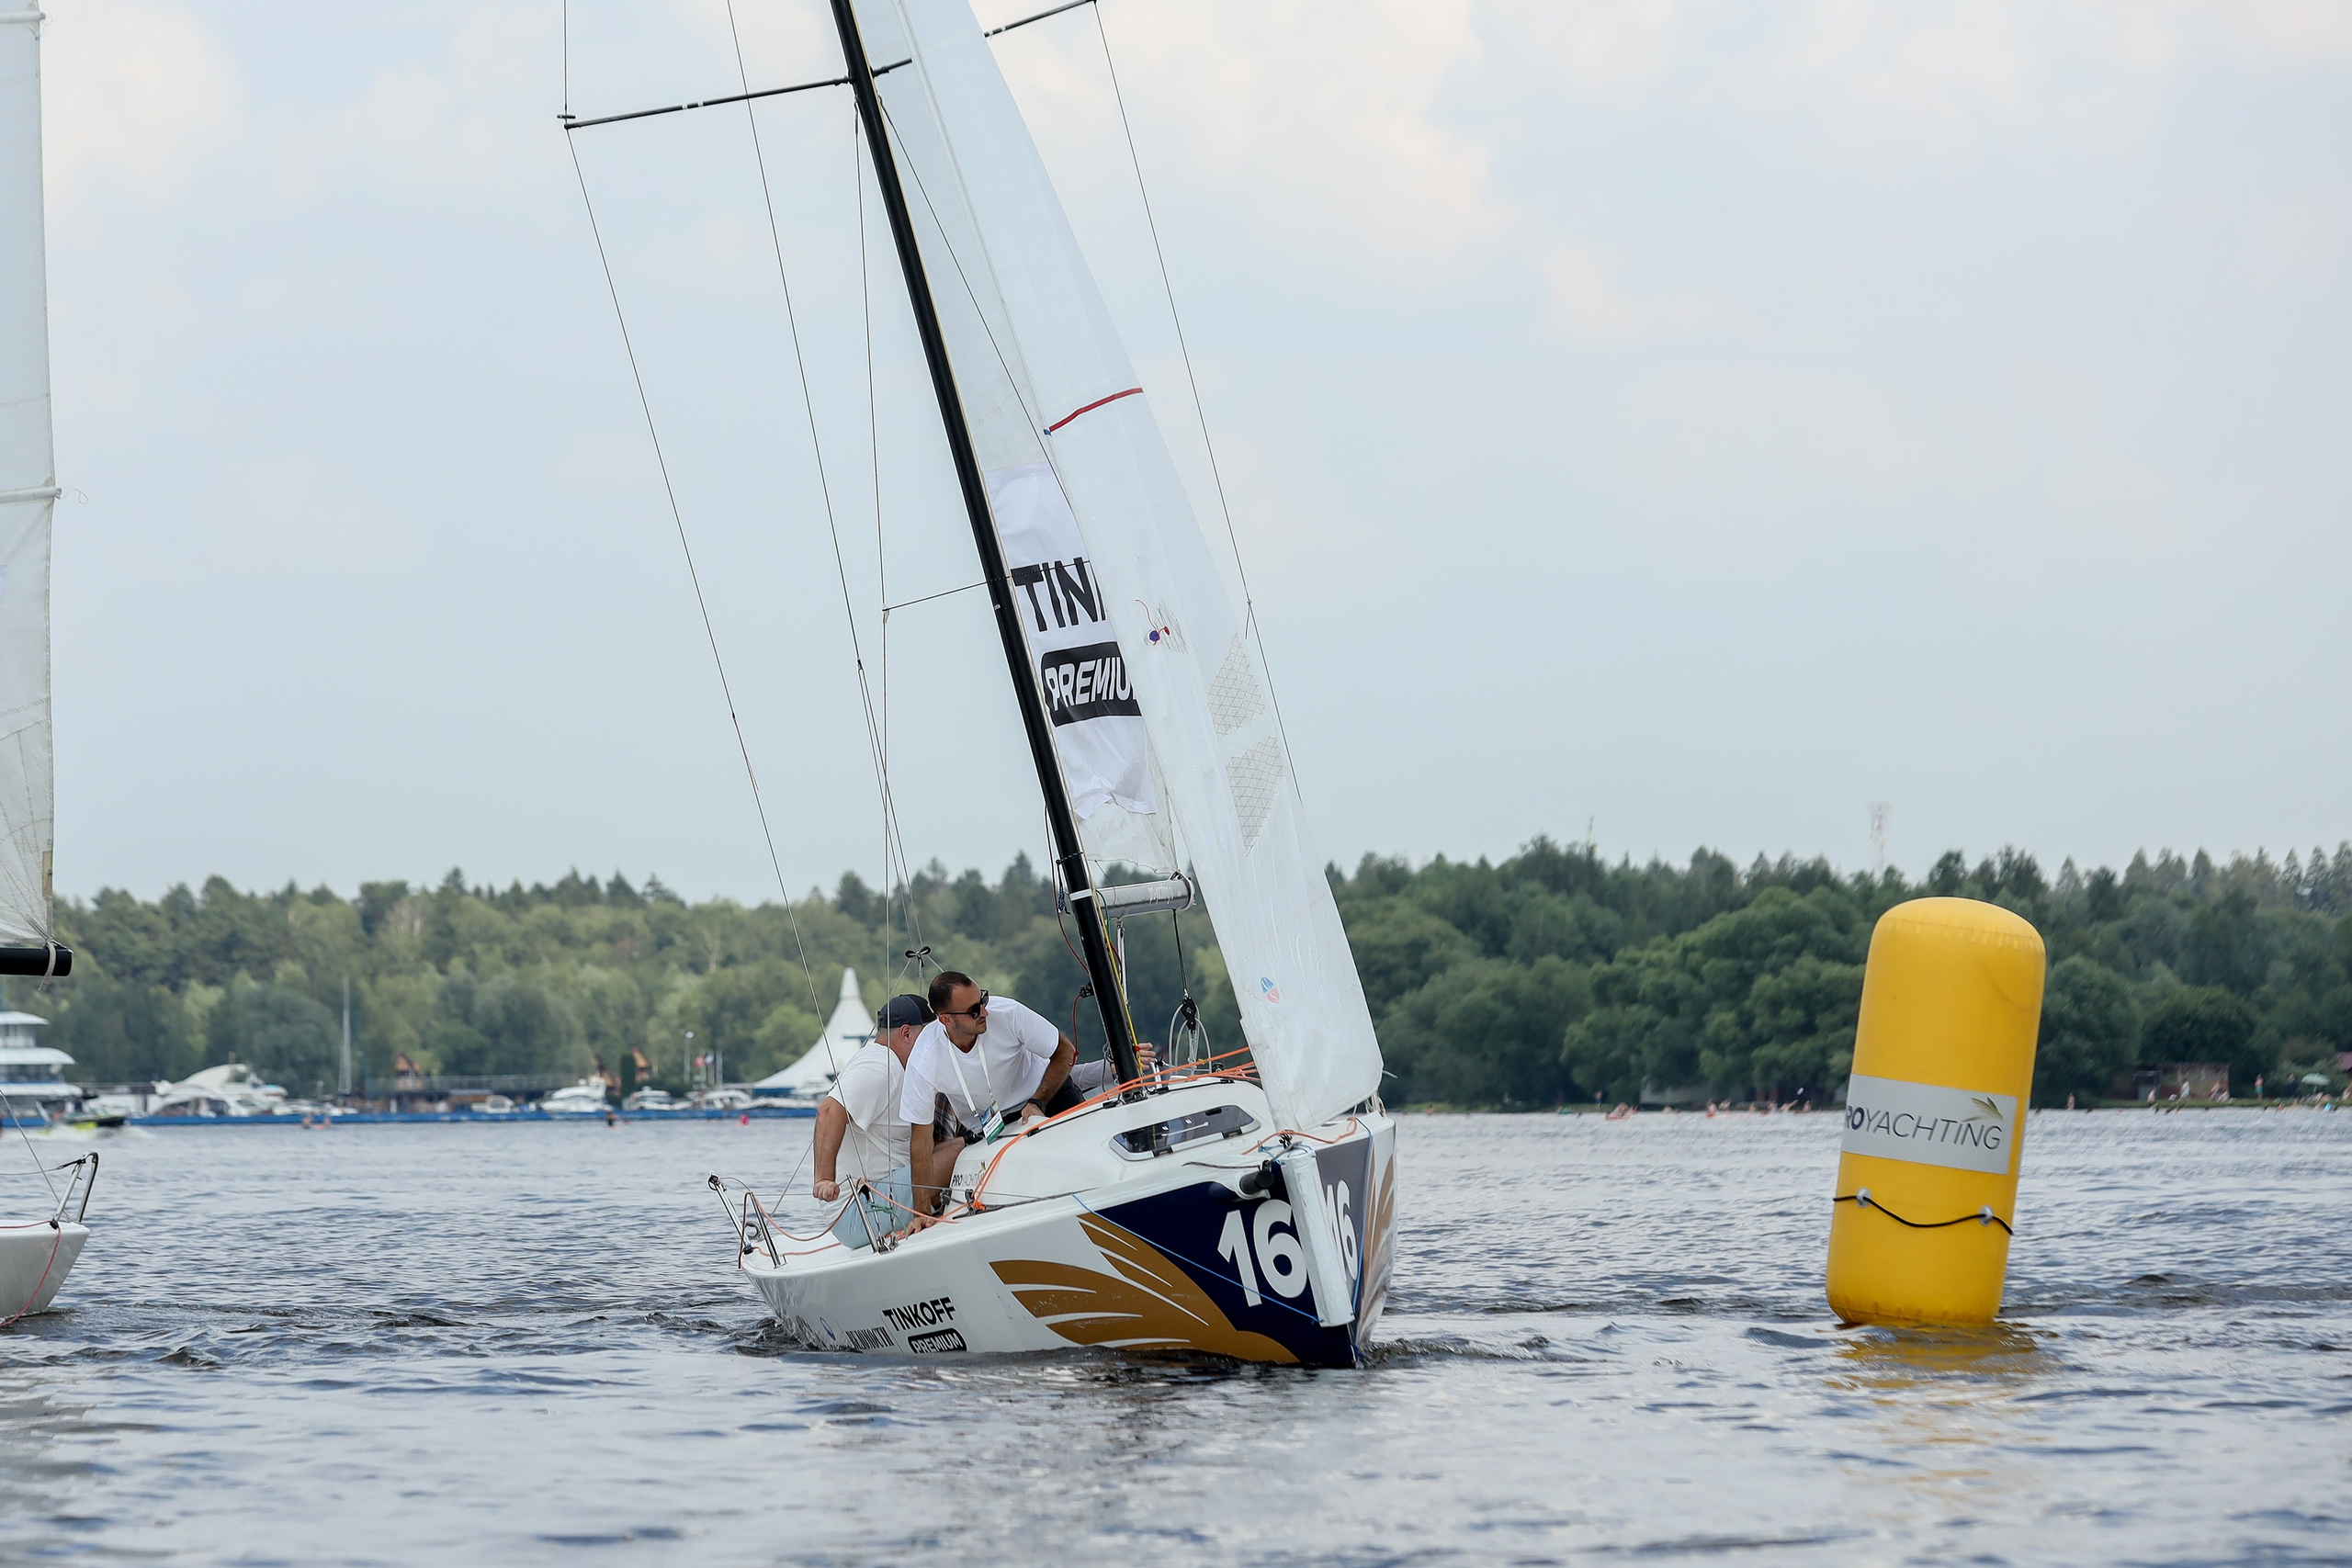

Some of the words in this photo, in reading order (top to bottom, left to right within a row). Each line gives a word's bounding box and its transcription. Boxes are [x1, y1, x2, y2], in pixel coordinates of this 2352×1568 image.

[1045, 657, 1136, 711] PREMIU
[1846, 1105, 2002, 1150] ROYACHTING
[1217, 1199, 1307, 1307] 16
[882, 1297, 956, 1331] TINKOFF
[910, 1332, 963, 1354] PREMIUM
